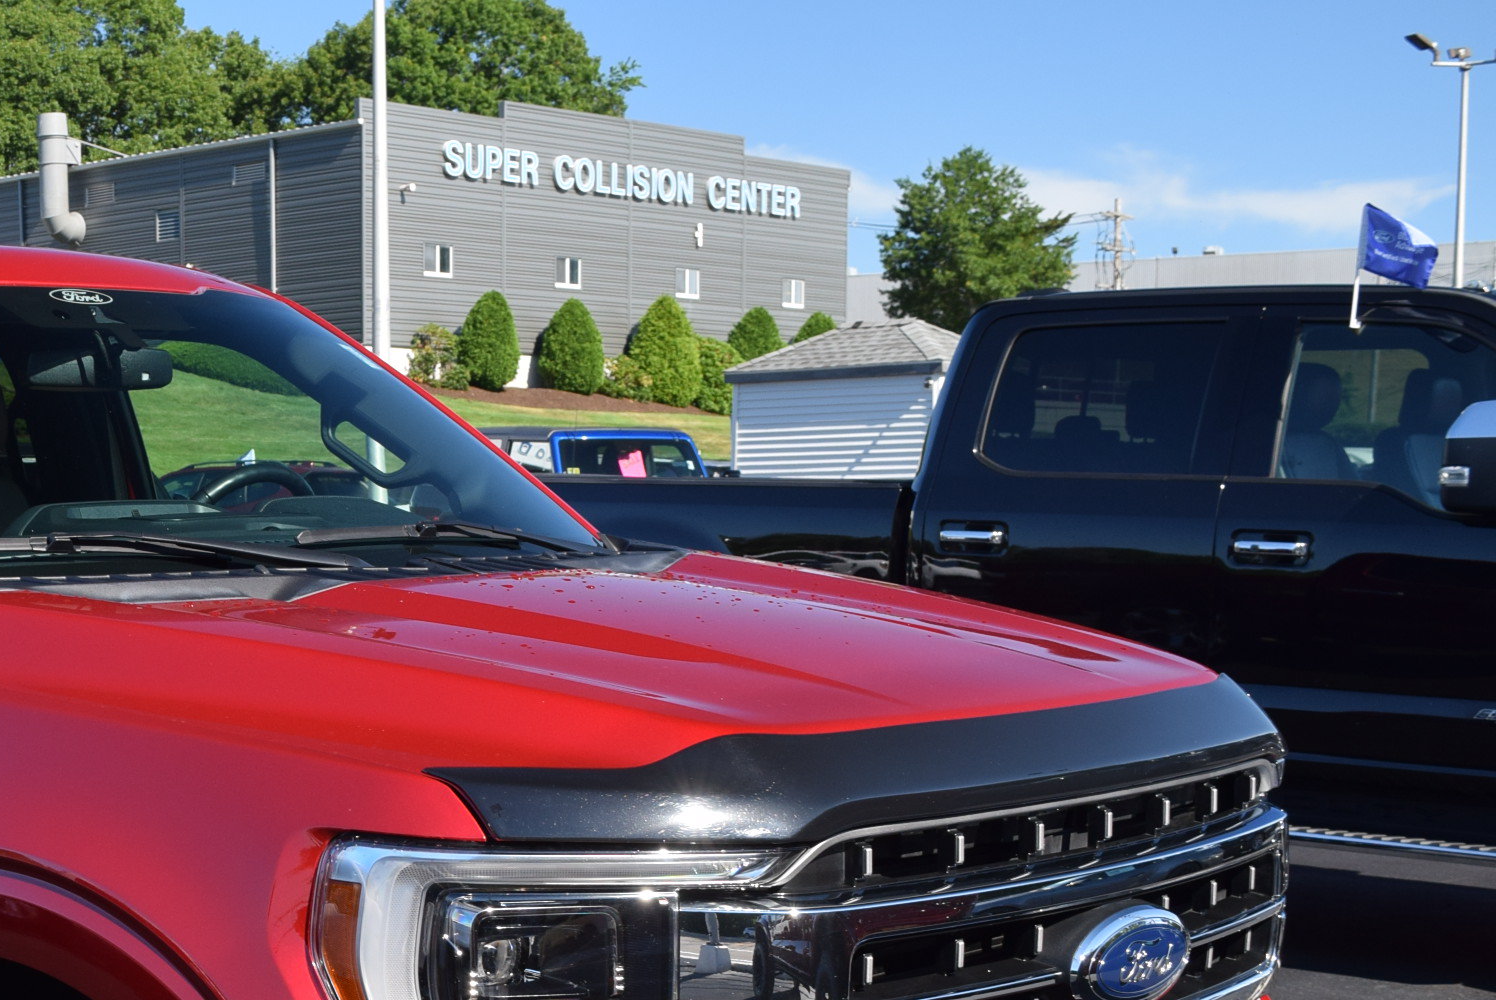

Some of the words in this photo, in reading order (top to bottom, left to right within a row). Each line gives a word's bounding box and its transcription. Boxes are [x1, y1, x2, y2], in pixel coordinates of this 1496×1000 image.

[443, 140, 540, 186] SUPER
[554, 154, 694, 206] COLLISION
[707, 175, 801, 219] CENTER
[61, 290, 104, 302] Ford
[1120, 938, 1174, 984] Ford
